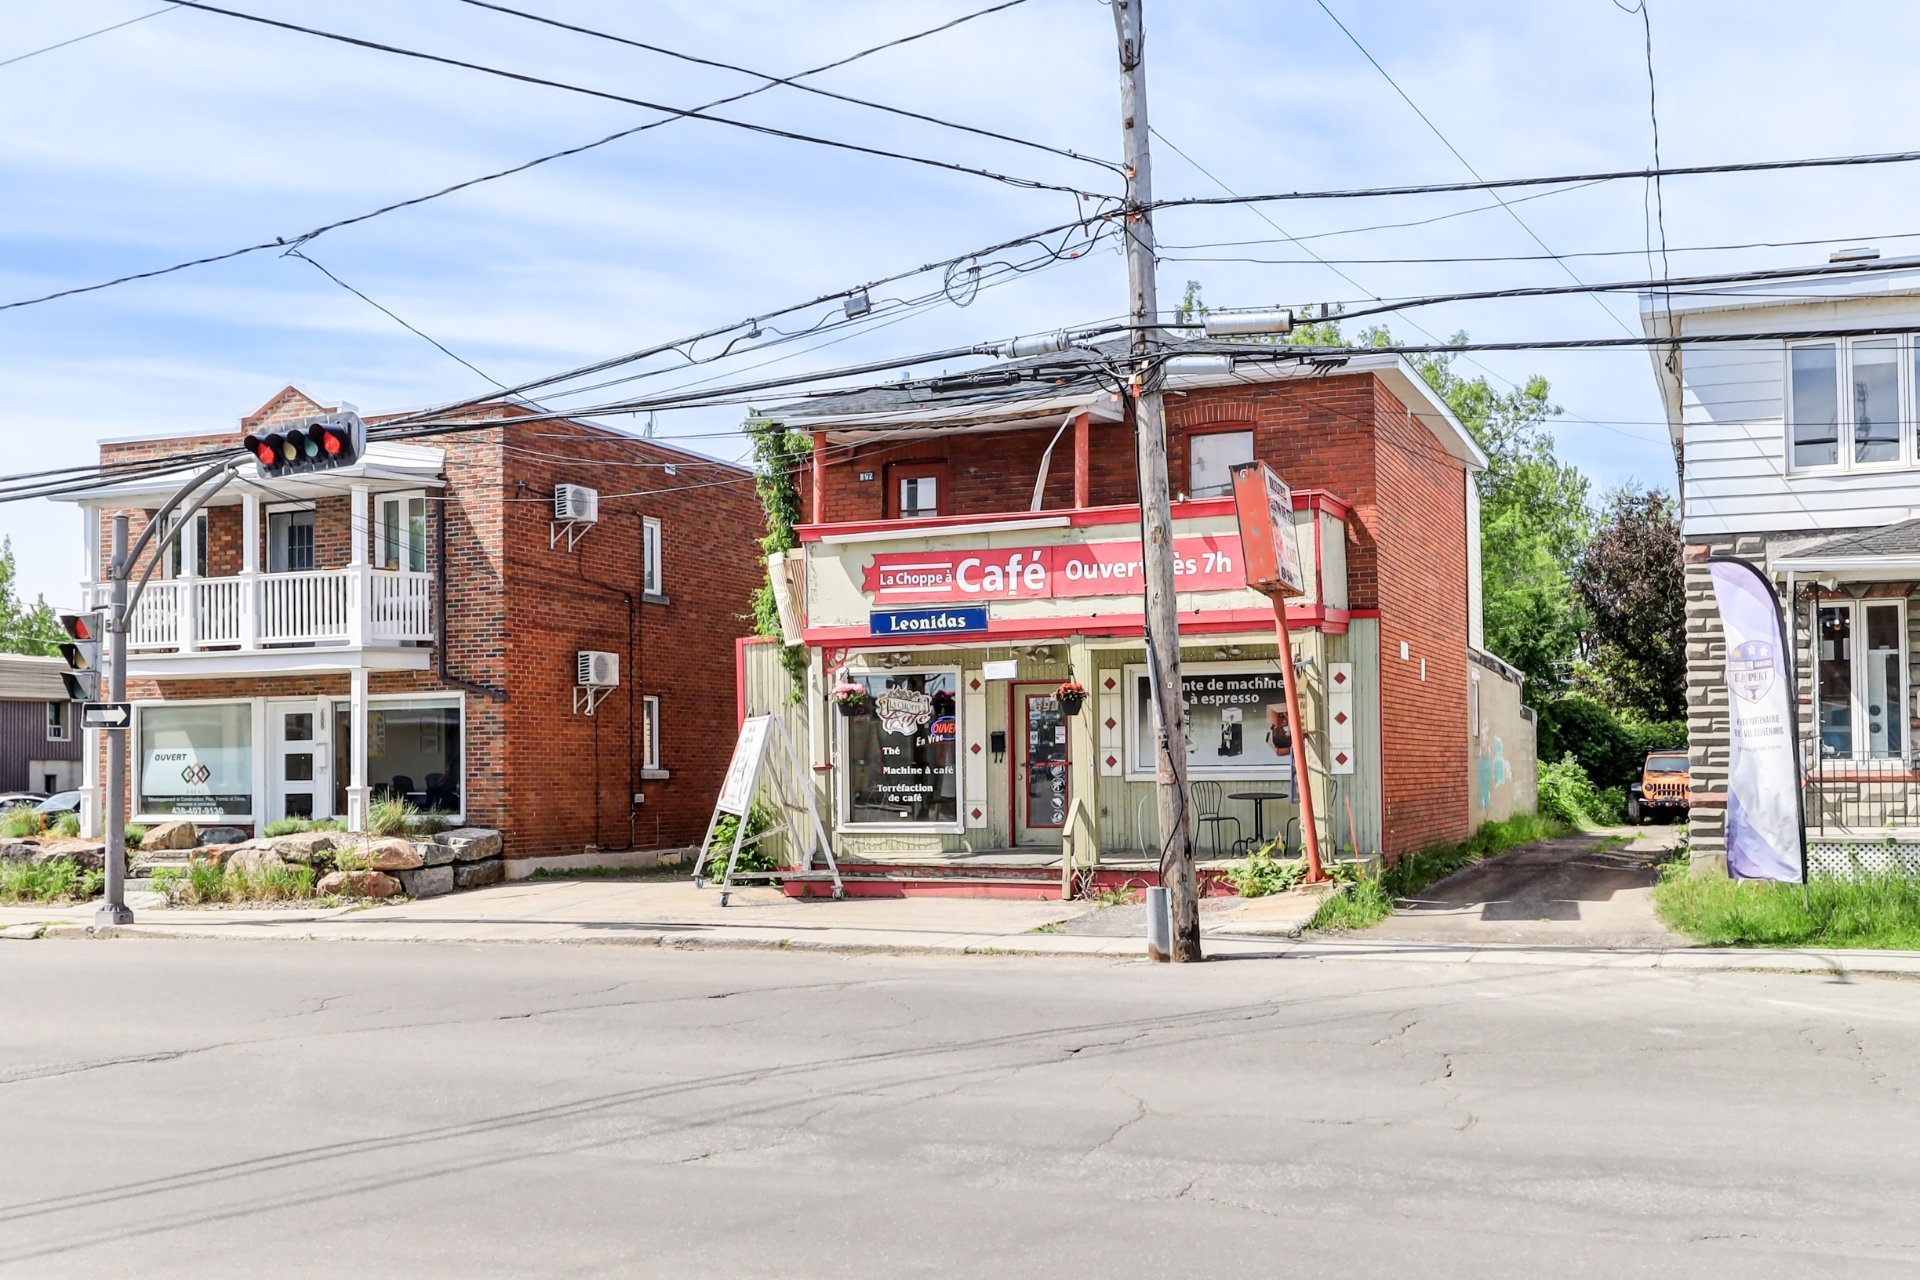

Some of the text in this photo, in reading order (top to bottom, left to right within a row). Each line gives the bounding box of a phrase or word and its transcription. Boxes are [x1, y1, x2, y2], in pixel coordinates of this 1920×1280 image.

[1173, 552, 1198, 576] ès
[1201, 550, 1232, 574] 7h
[879, 569, 953, 588] La Choppe à
[955, 550, 1046, 596] Café
[890, 612, 966, 631] Leonidas
[1182, 677, 1284, 692] nte de machine
[1190, 693, 1260, 707] à espresso
[916, 736, 926, 747] En
[882, 746, 901, 755] Thé
[154, 753, 188, 761] OUVERT
[883, 765, 954, 775] Machine à café
[877, 783, 934, 792] Torréfaction
[888, 793, 923, 802] de café
